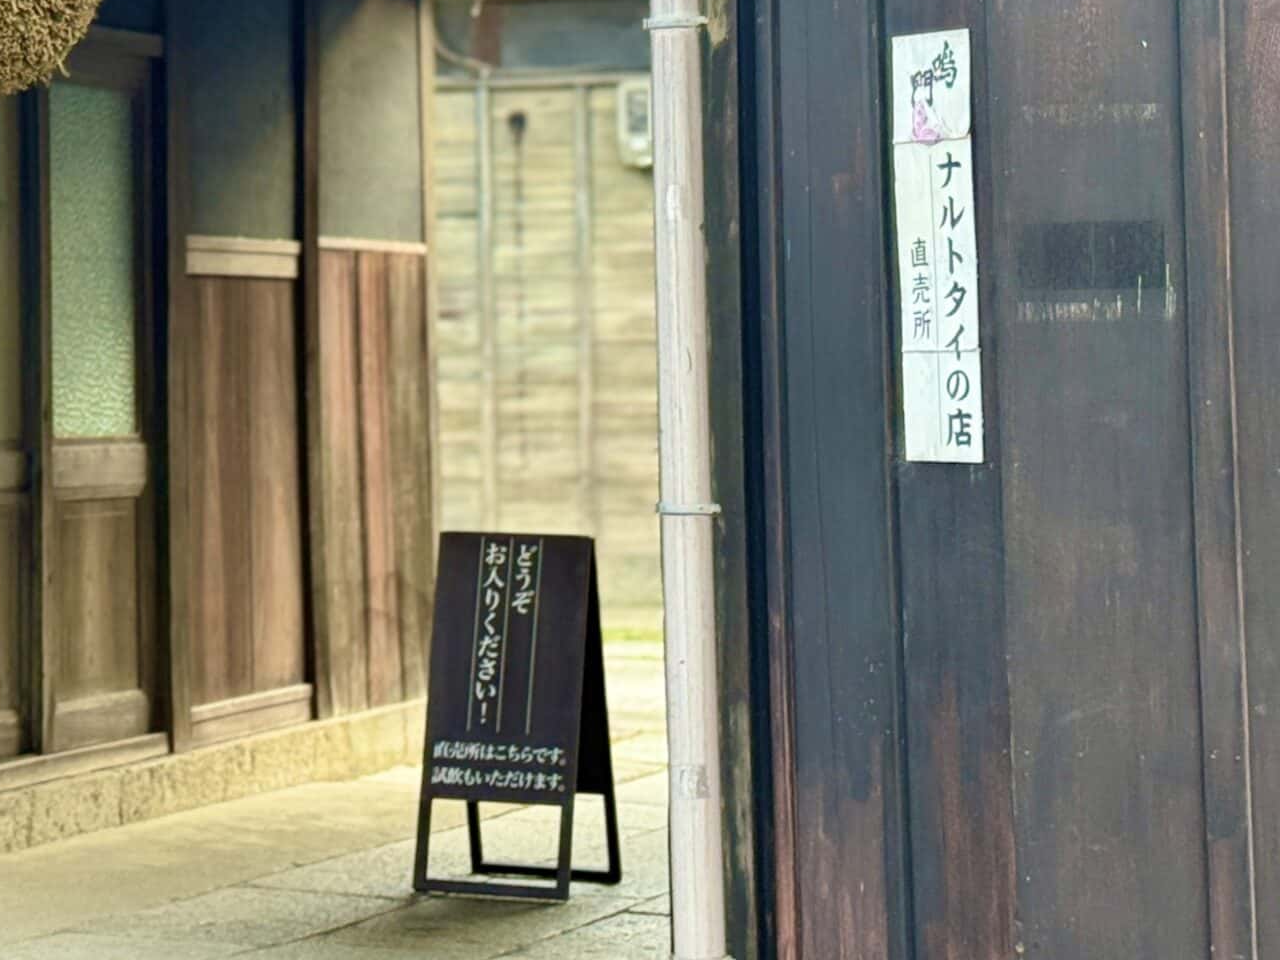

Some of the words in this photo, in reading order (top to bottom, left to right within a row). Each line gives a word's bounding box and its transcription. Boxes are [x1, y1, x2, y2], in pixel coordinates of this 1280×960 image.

[910, 237, 931, 340] 直売所
[937, 151, 973, 447] ナルトタイの店
[511, 544, 538, 615] どうぞ
